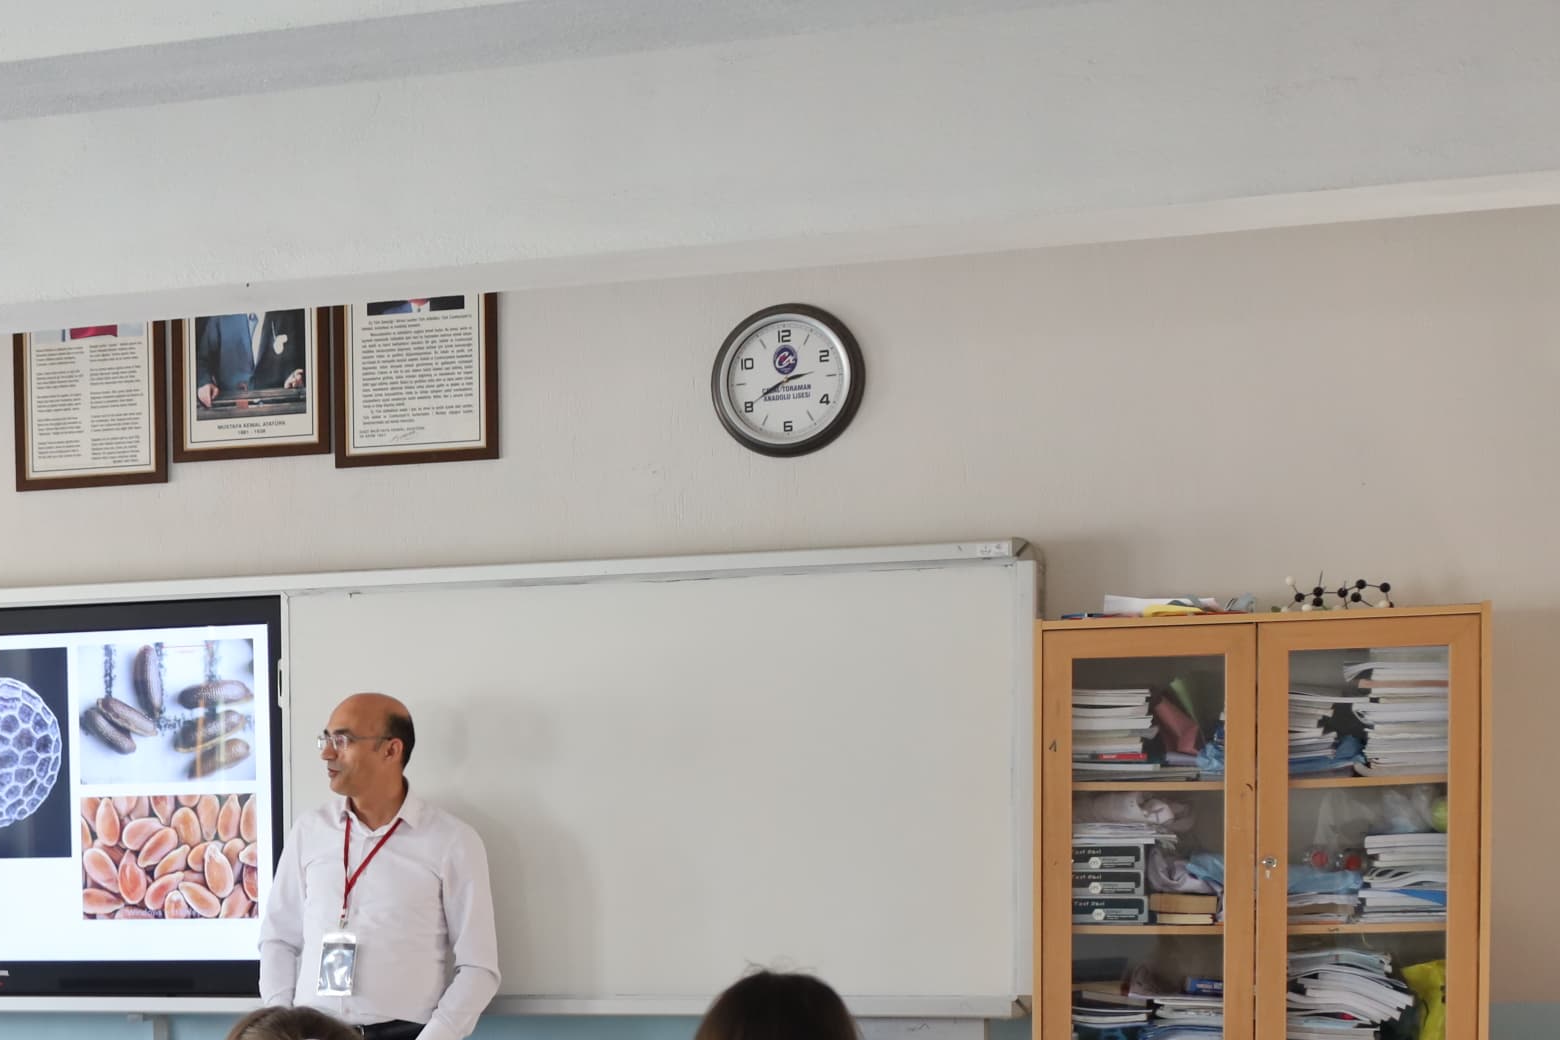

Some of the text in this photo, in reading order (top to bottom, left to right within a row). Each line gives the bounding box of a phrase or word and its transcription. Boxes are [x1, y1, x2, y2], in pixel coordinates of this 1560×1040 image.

[778, 329, 792, 343] 12
[819, 349, 830, 363] 2
[740, 357, 754, 371] 10
[819, 393, 830, 405] 4
[744, 401, 754, 413] 8
[783, 420, 793, 432] 6
